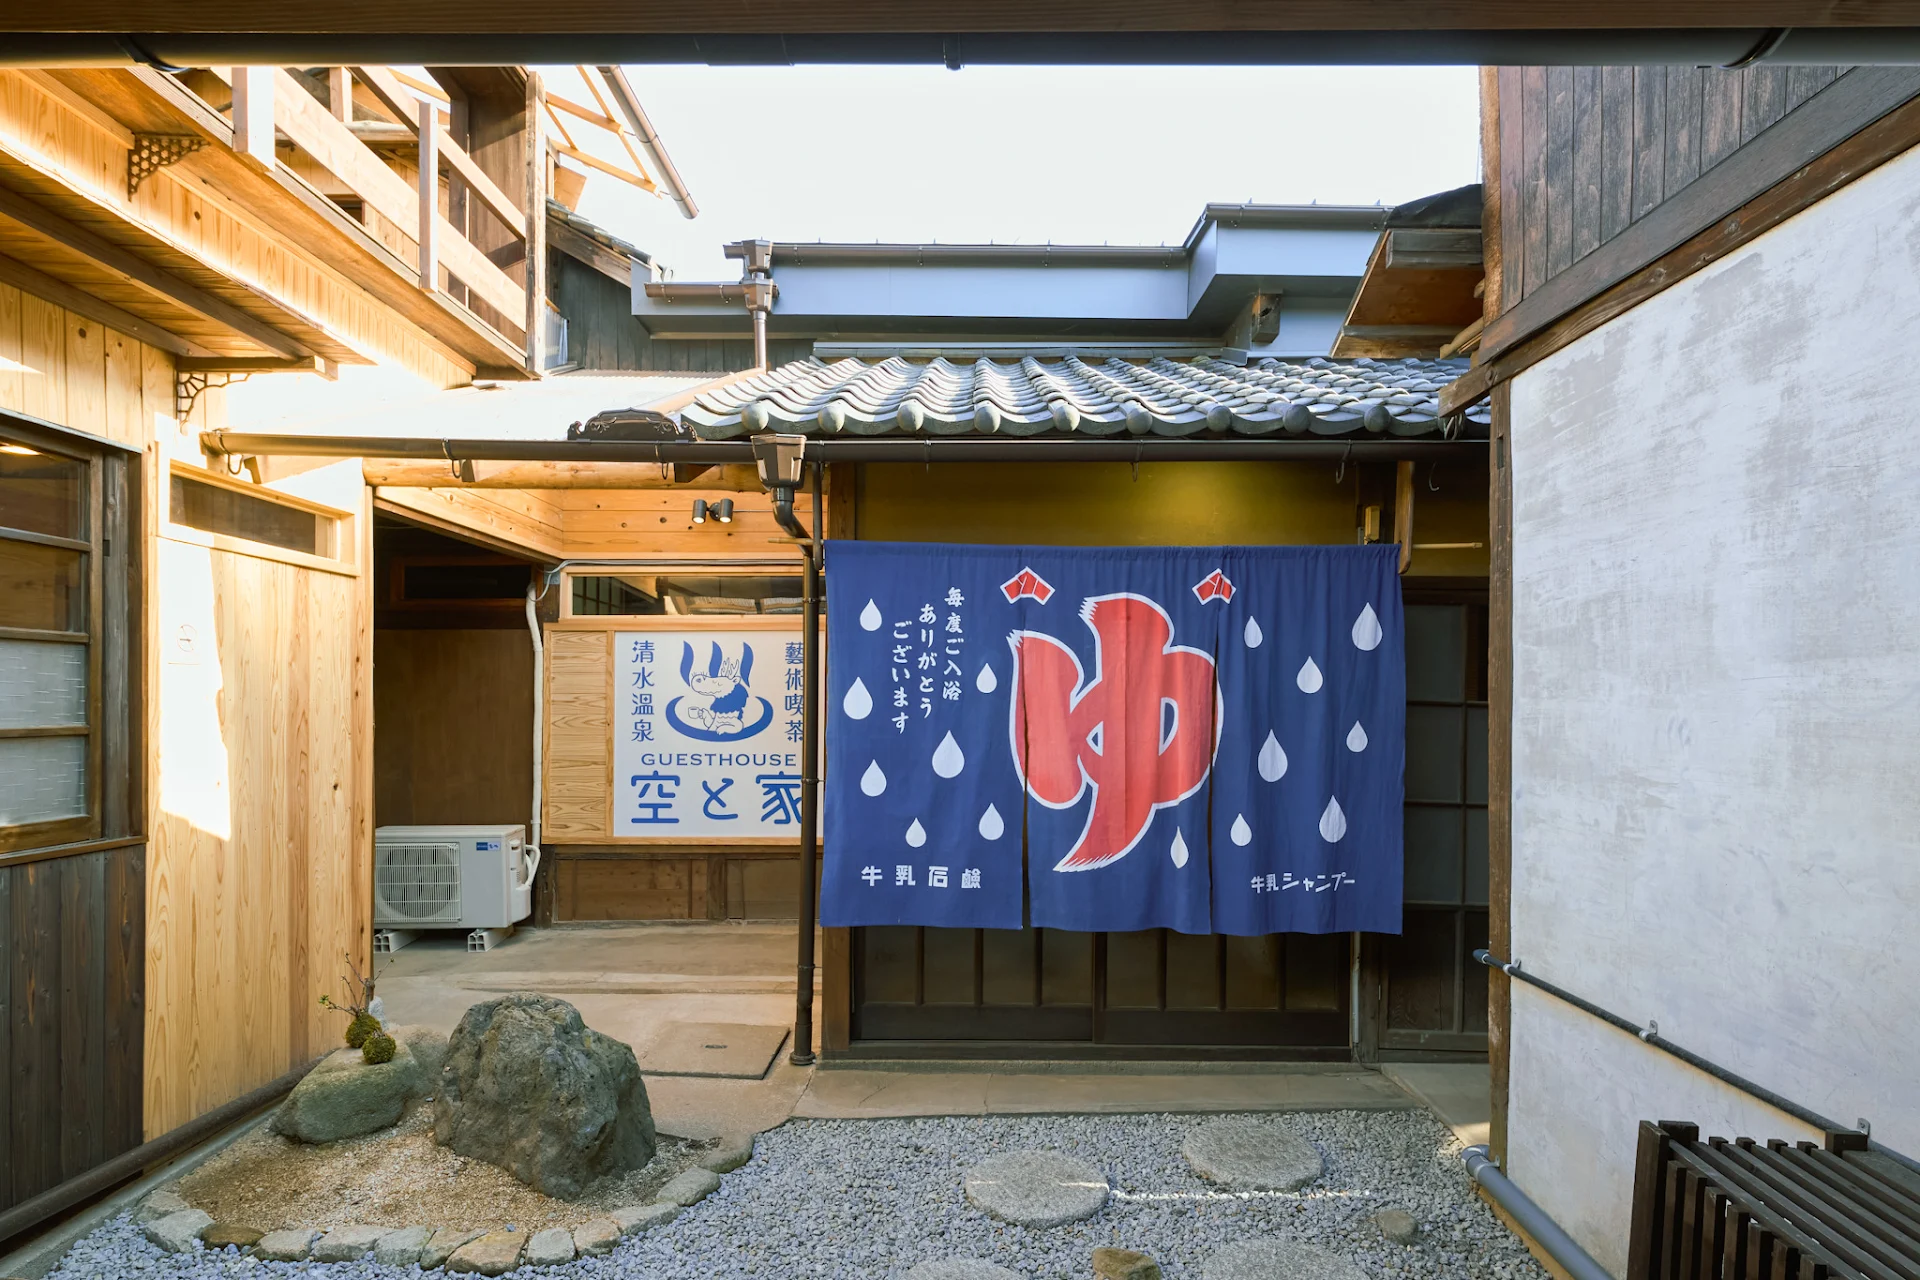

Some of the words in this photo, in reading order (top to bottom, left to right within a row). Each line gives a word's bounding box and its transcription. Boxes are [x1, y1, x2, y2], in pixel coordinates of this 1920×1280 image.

[891, 620, 912, 734] ございます
[917, 603, 937, 719] ありがとう
[942, 586, 965, 701] 毎度ご入浴
[641, 753, 796, 766] GUESTHOUSE
[1006, 592, 1224, 872] ゆ
[631, 770, 803, 824] 空と家
[1250, 871, 1355, 894] 牛乳シャンプー
